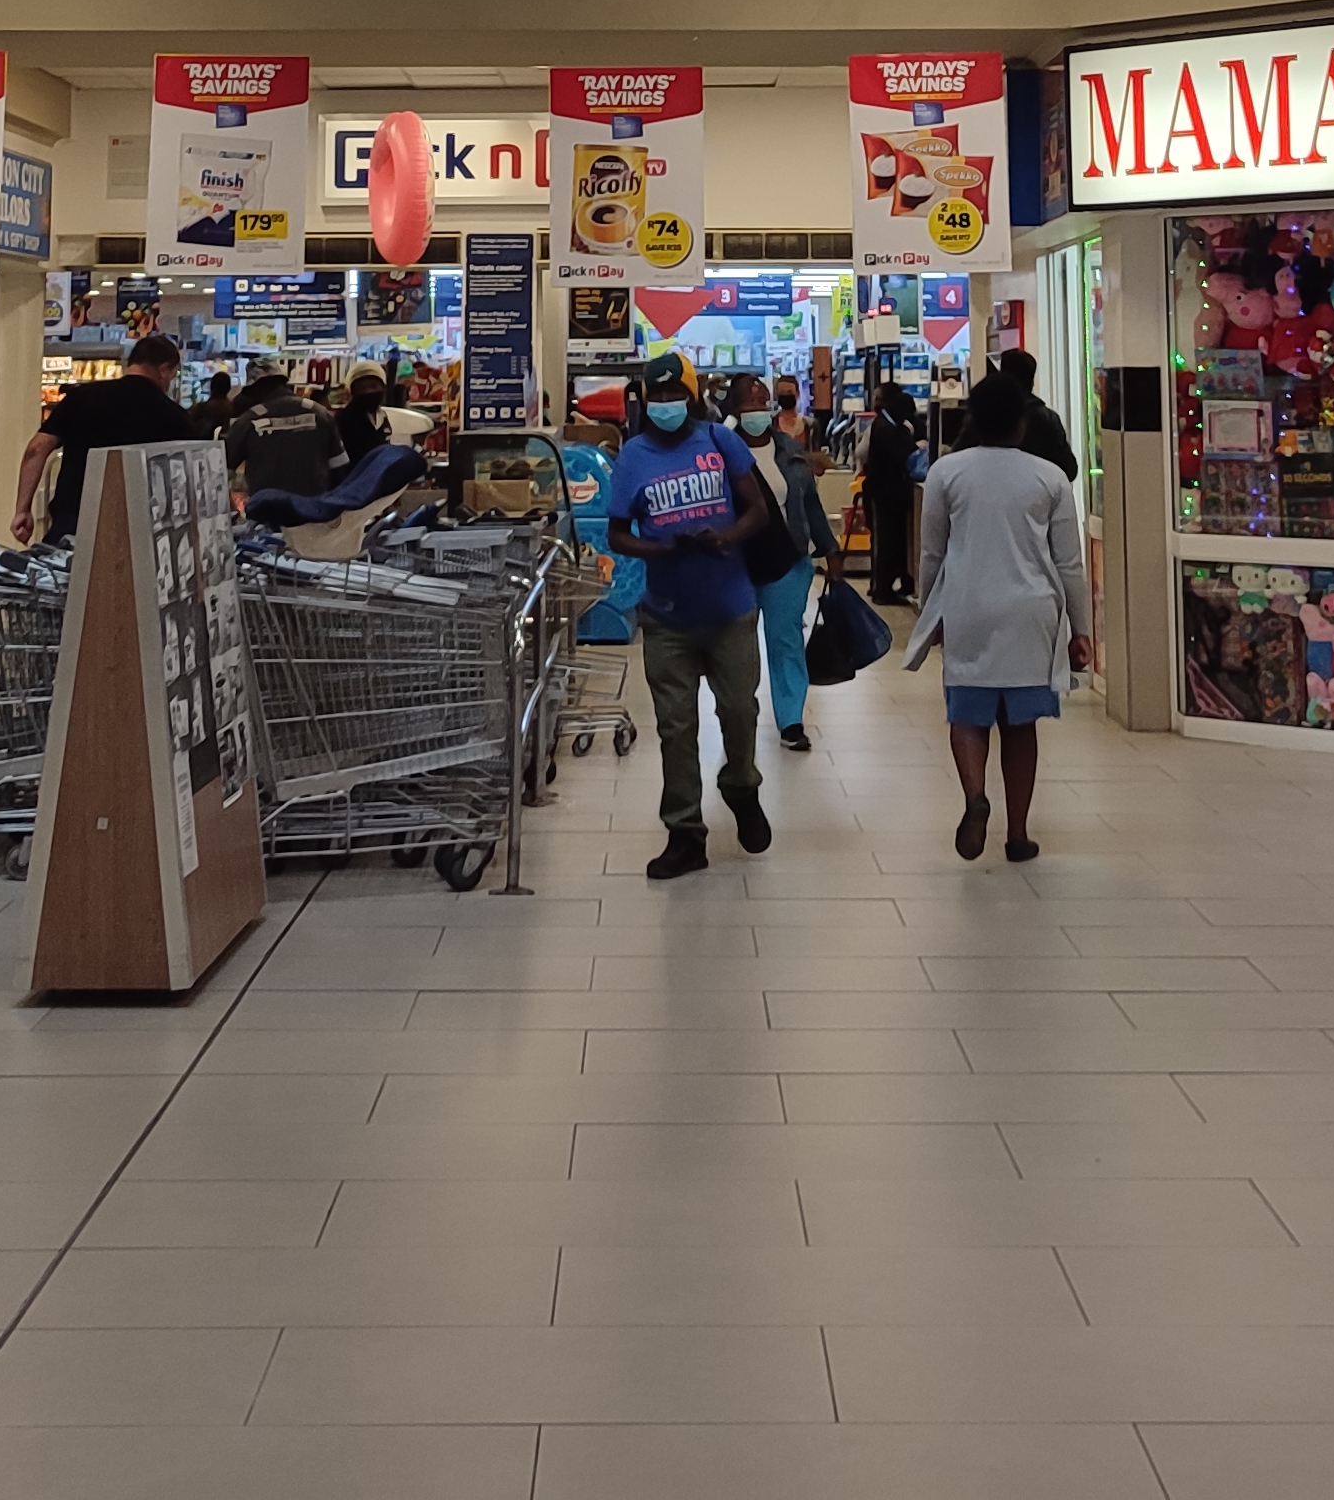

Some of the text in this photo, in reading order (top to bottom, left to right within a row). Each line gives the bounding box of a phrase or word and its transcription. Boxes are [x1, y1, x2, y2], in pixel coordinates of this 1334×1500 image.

[190, 79, 271, 95] SAVINGS
[885, 77, 966, 93] SAVINGS
[585, 91, 666, 106] SAVINGS
[490, 143, 522, 180] n
[646, 161, 664, 175] TV
[21, 161, 45, 196] CITY
[200, 168, 245, 189] finish
[939, 169, 980, 182] Spekko
[578, 169, 643, 199] Ricoffy
[940, 202, 968, 213] 2 FOR
[647, 219, 680, 237] R74
[937, 212, 971, 229] R48
[157, 253, 224, 268] Pick n Pay
[864, 252, 930, 266] Pick n Pay
[558, 264, 625, 279] Pick n Pay
[945, 289, 957, 303] 4
